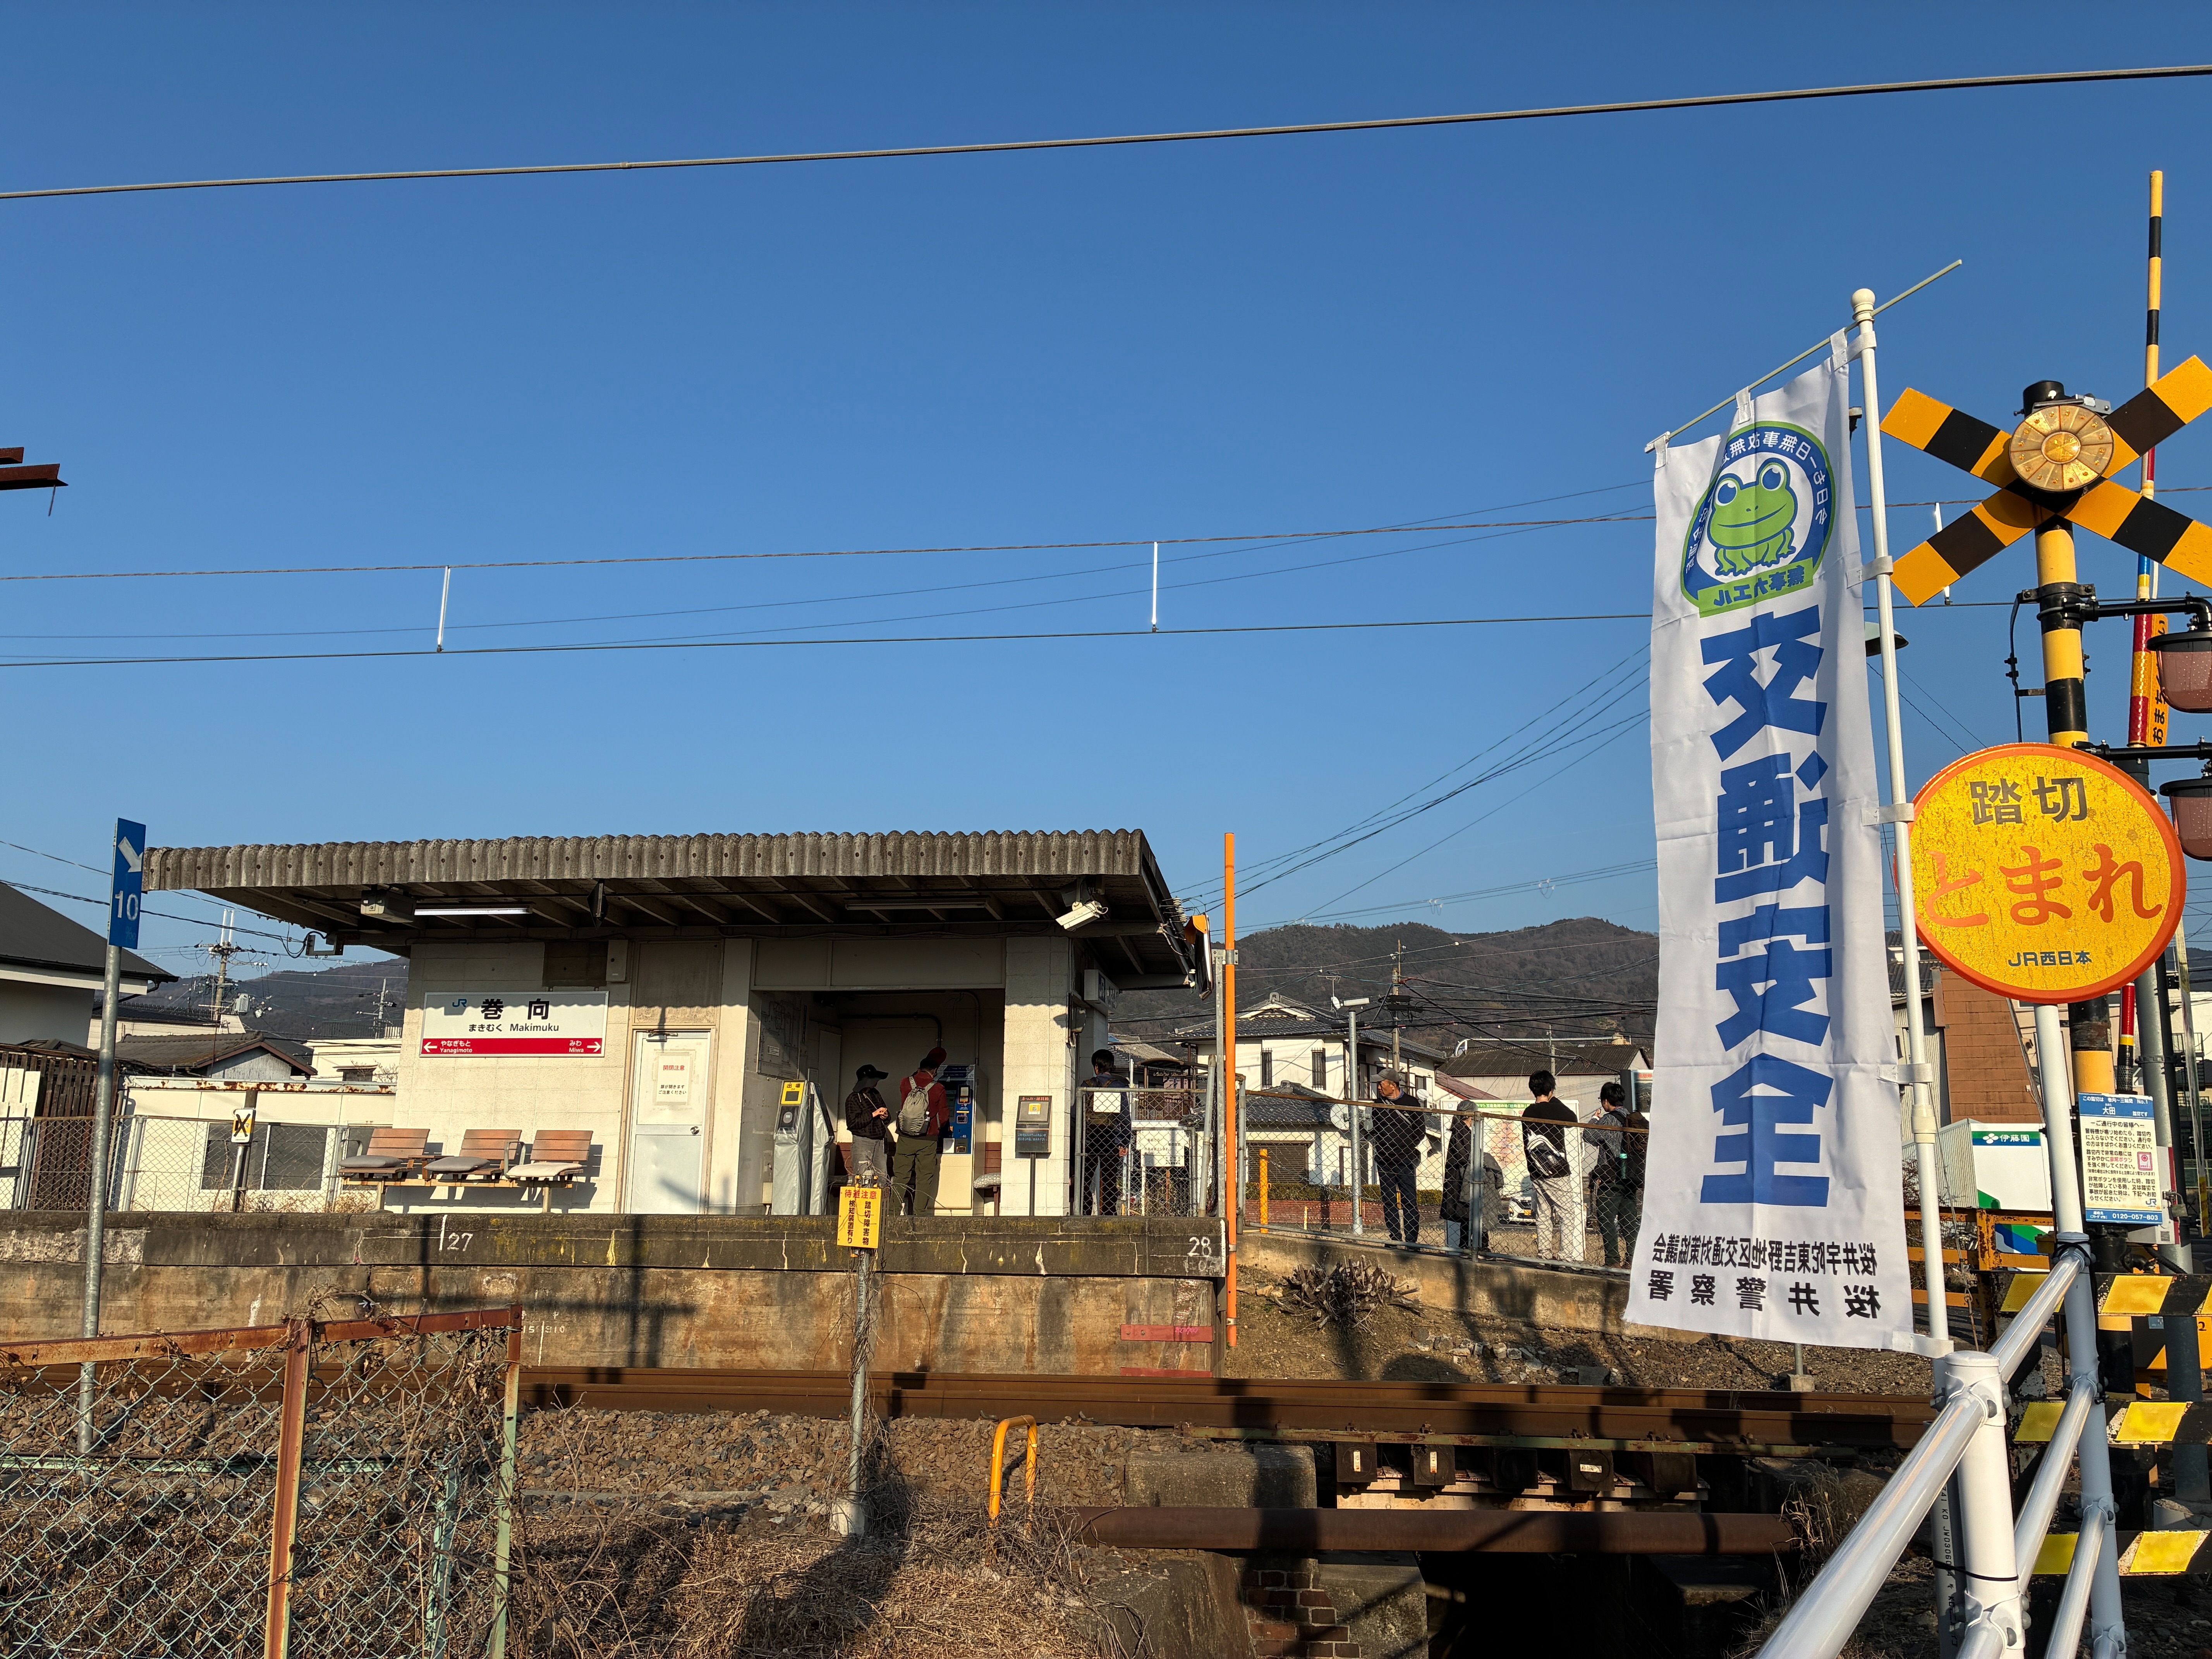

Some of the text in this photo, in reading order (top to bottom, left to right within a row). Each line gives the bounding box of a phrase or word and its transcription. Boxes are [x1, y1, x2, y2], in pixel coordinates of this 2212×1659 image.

[1970, 776, 2089, 827] 踏切
[1924, 843, 2163, 928] とまれ
[115, 890, 139, 921] 10
[2008, 950, 2092, 967] JR西日本
[452, 999, 467, 1007] JR
[481, 998, 550, 1020] 巻向
[469, 1023, 559, 1032] まきむく Makimuku
[847, 1200, 856, 1244] 検知装置有り
[862, 1201, 871, 1245] 踏切障害物
[447, 1232, 473, 1252] 27
[1187, 1237, 1212, 1257] 28
[2198, 1321, 2207, 1331] 2
